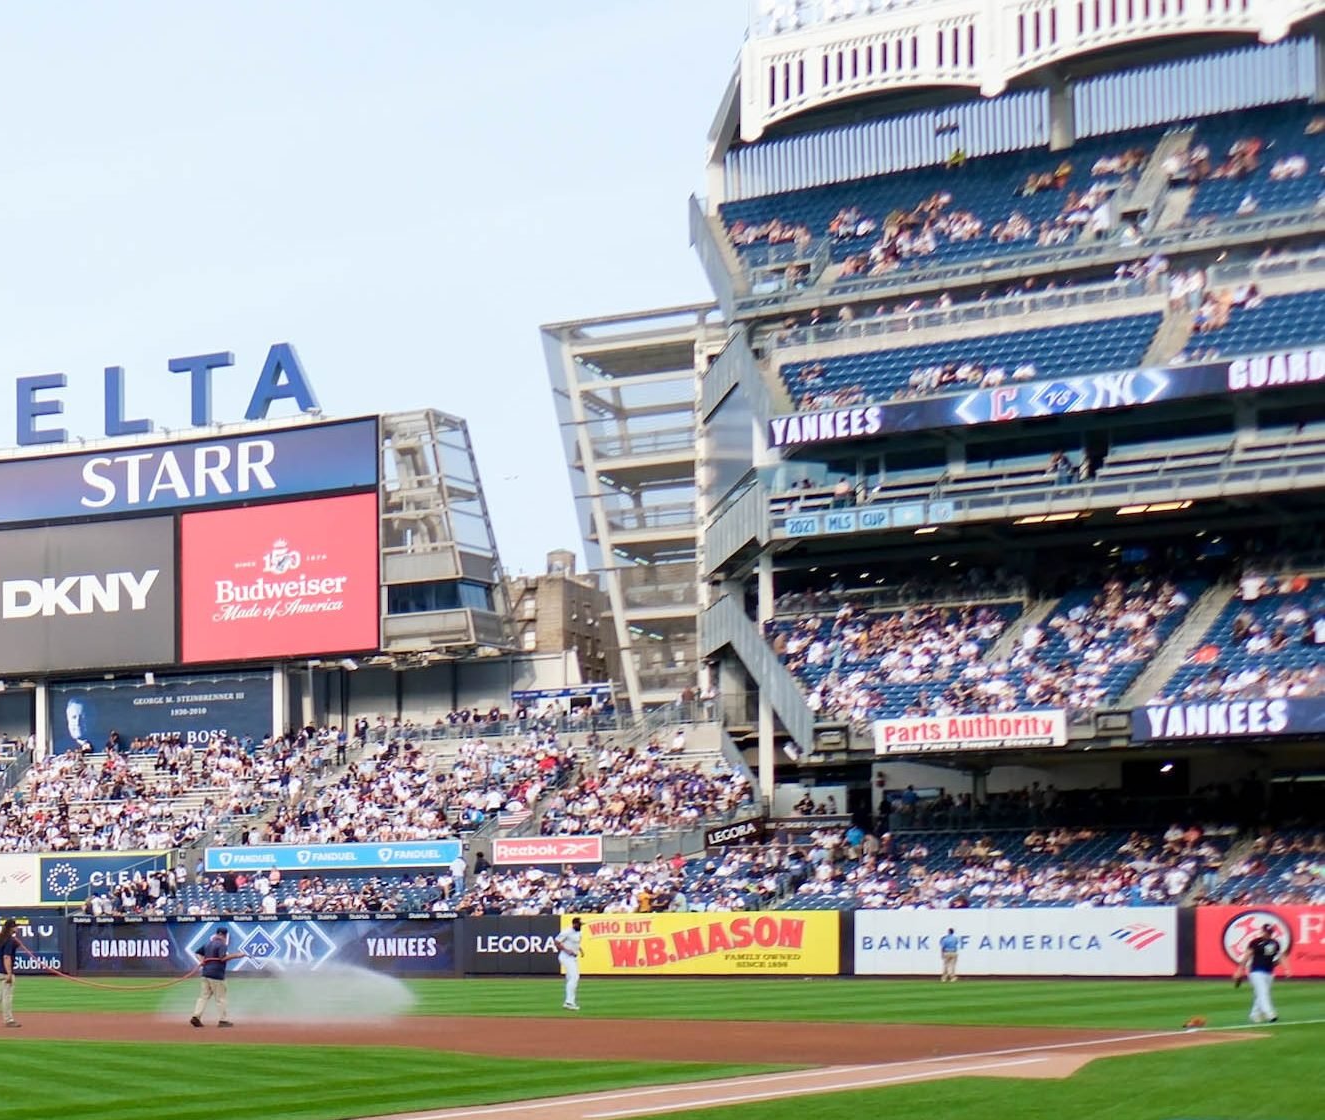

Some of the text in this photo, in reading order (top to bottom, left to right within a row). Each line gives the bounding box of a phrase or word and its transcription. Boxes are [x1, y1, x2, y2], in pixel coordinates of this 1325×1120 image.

[771, 406, 882, 446] YANKEES
[80, 440, 277, 508] STARR
[788, 511, 886, 534] 2021 MLS CUP
[2, 569, 160, 619] DKNY
[215, 573, 347, 603] Budweiser
[212, 598, 344, 622] Made of America
[133, 697, 165, 706] GEORGE
[176, 693, 235, 703] STEINBRENNER
[884, 715, 1055, 742] Parts Authority
[1146, 700, 1291, 738] YANKEES
[187, 729, 227, 744] BOSS
[707, 822, 757, 845] LEGORA
[233, 849, 440, 864] FANDUEL FANDUEL FANDUEL
[496, 843, 558, 860] Reebok
[589, 919, 652, 936] WHO BUT
[91, 938, 169, 957] GUARDIANS
[367, 937, 437, 957] YANKEES
[476, 935, 559, 953] LEGORA
[862, 934, 931, 950] BANK
[978, 934, 1103, 950] AMERICA
[763, 953, 801, 961] OWNED
